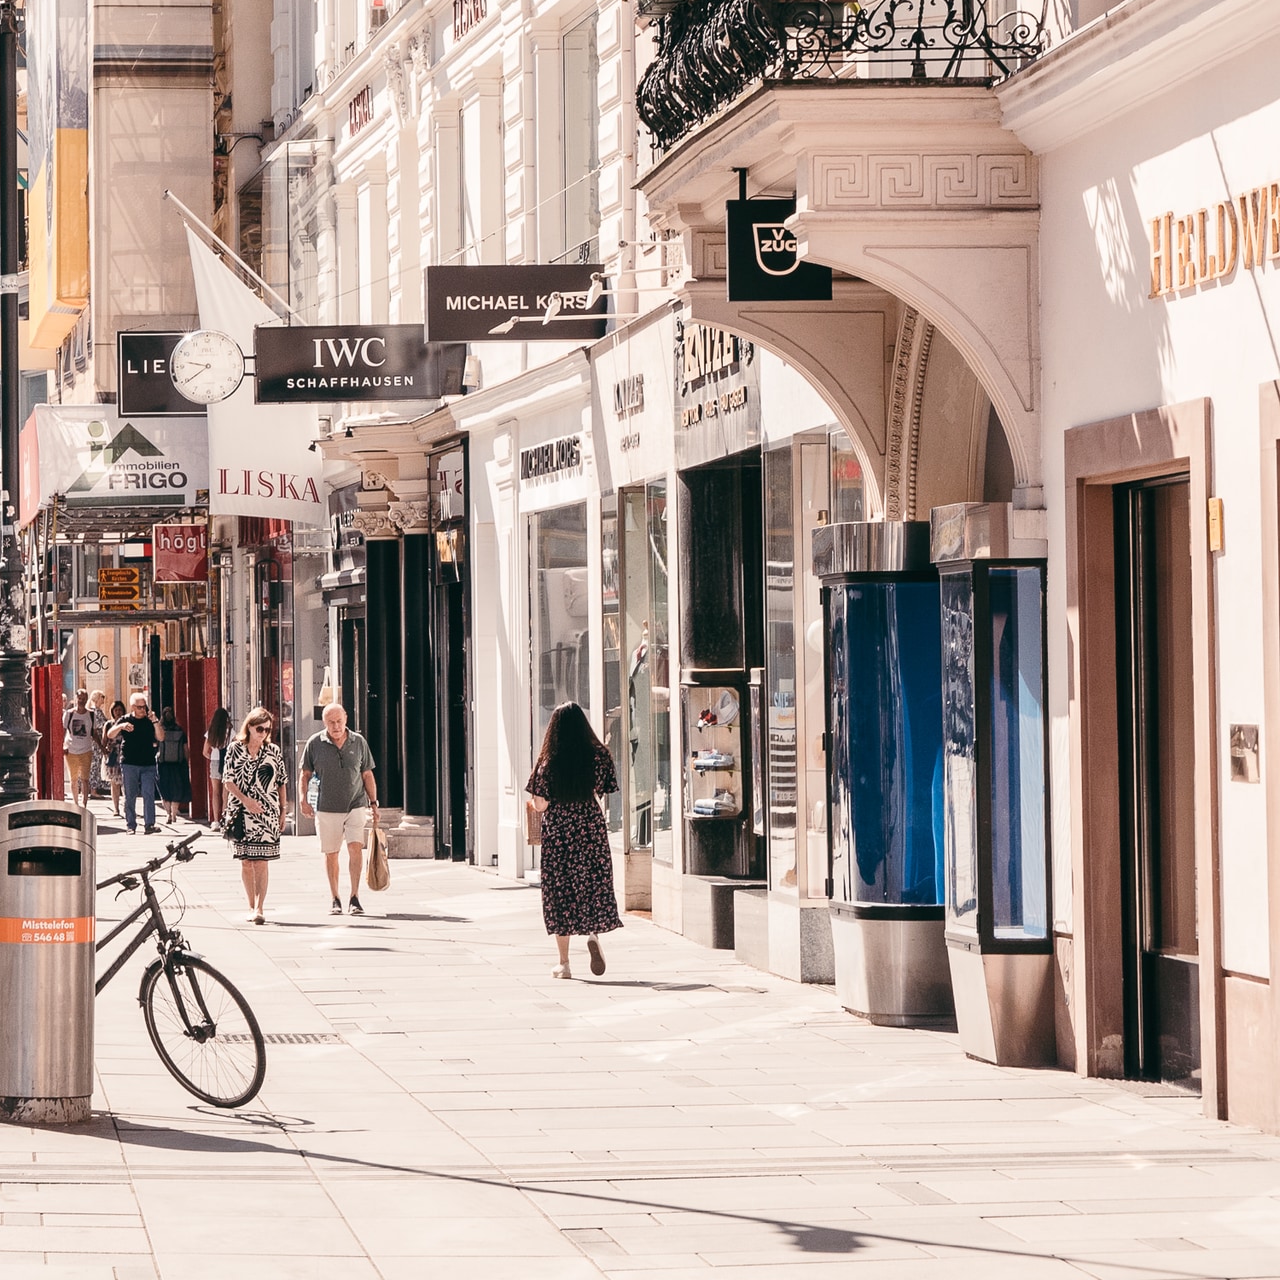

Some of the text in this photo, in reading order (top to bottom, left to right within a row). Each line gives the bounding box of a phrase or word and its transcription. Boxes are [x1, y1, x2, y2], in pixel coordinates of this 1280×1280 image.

[772, 229, 785, 241] V
[761, 240, 797, 252] ZUG
[446, 294, 529, 310] MICHAEL
[312, 337, 386, 368] IWC
[127, 359, 166, 374] LIE
[287, 376, 414, 389] SCHAFFHAUSEN
[109, 472, 188, 489] FRIGO
[217, 468, 322, 504] LISKA
[22, 919, 75, 930] Misttelefon
[33, 933, 65, 942] 546 48
